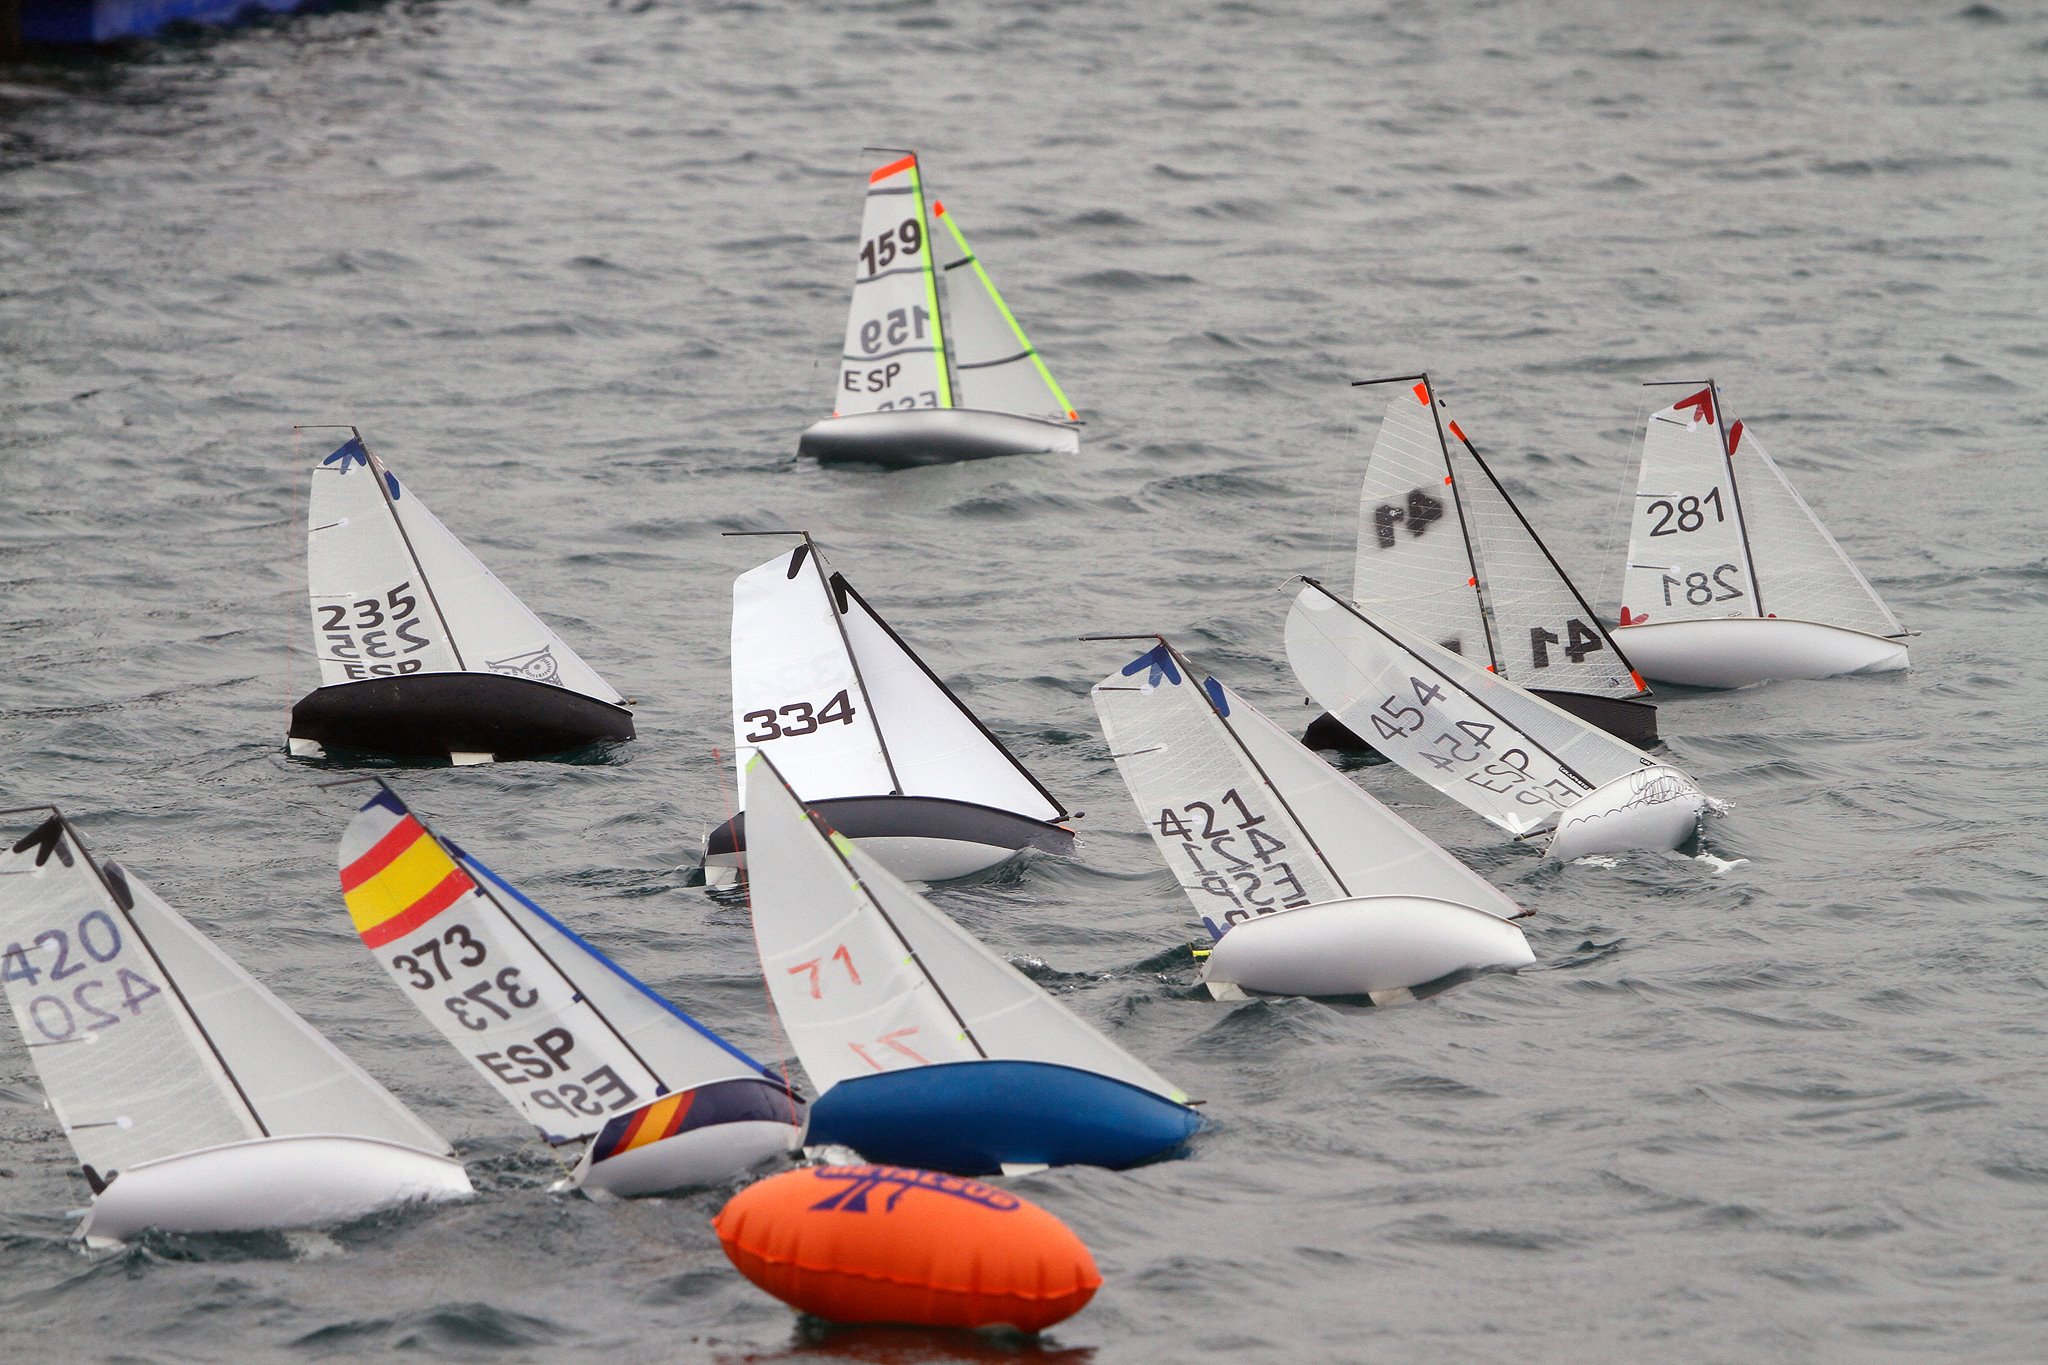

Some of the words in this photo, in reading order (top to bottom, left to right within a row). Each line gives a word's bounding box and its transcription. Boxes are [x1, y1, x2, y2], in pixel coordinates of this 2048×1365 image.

[860, 218, 921, 275] 159
[845, 362, 901, 392] ESP
[1647, 487, 1724, 536] 281
[318, 581, 416, 630] 235
[743, 689, 855, 743] 334
[1370, 677, 1447, 740] 454
[1465, 748, 1536, 794] ESP
[1160, 788, 1266, 841] 421
[1, 910, 122, 986] 420
[392, 924, 487, 990] 373
[788, 944, 862, 1000] 71
[476, 1027, 574, 1085] ESP
